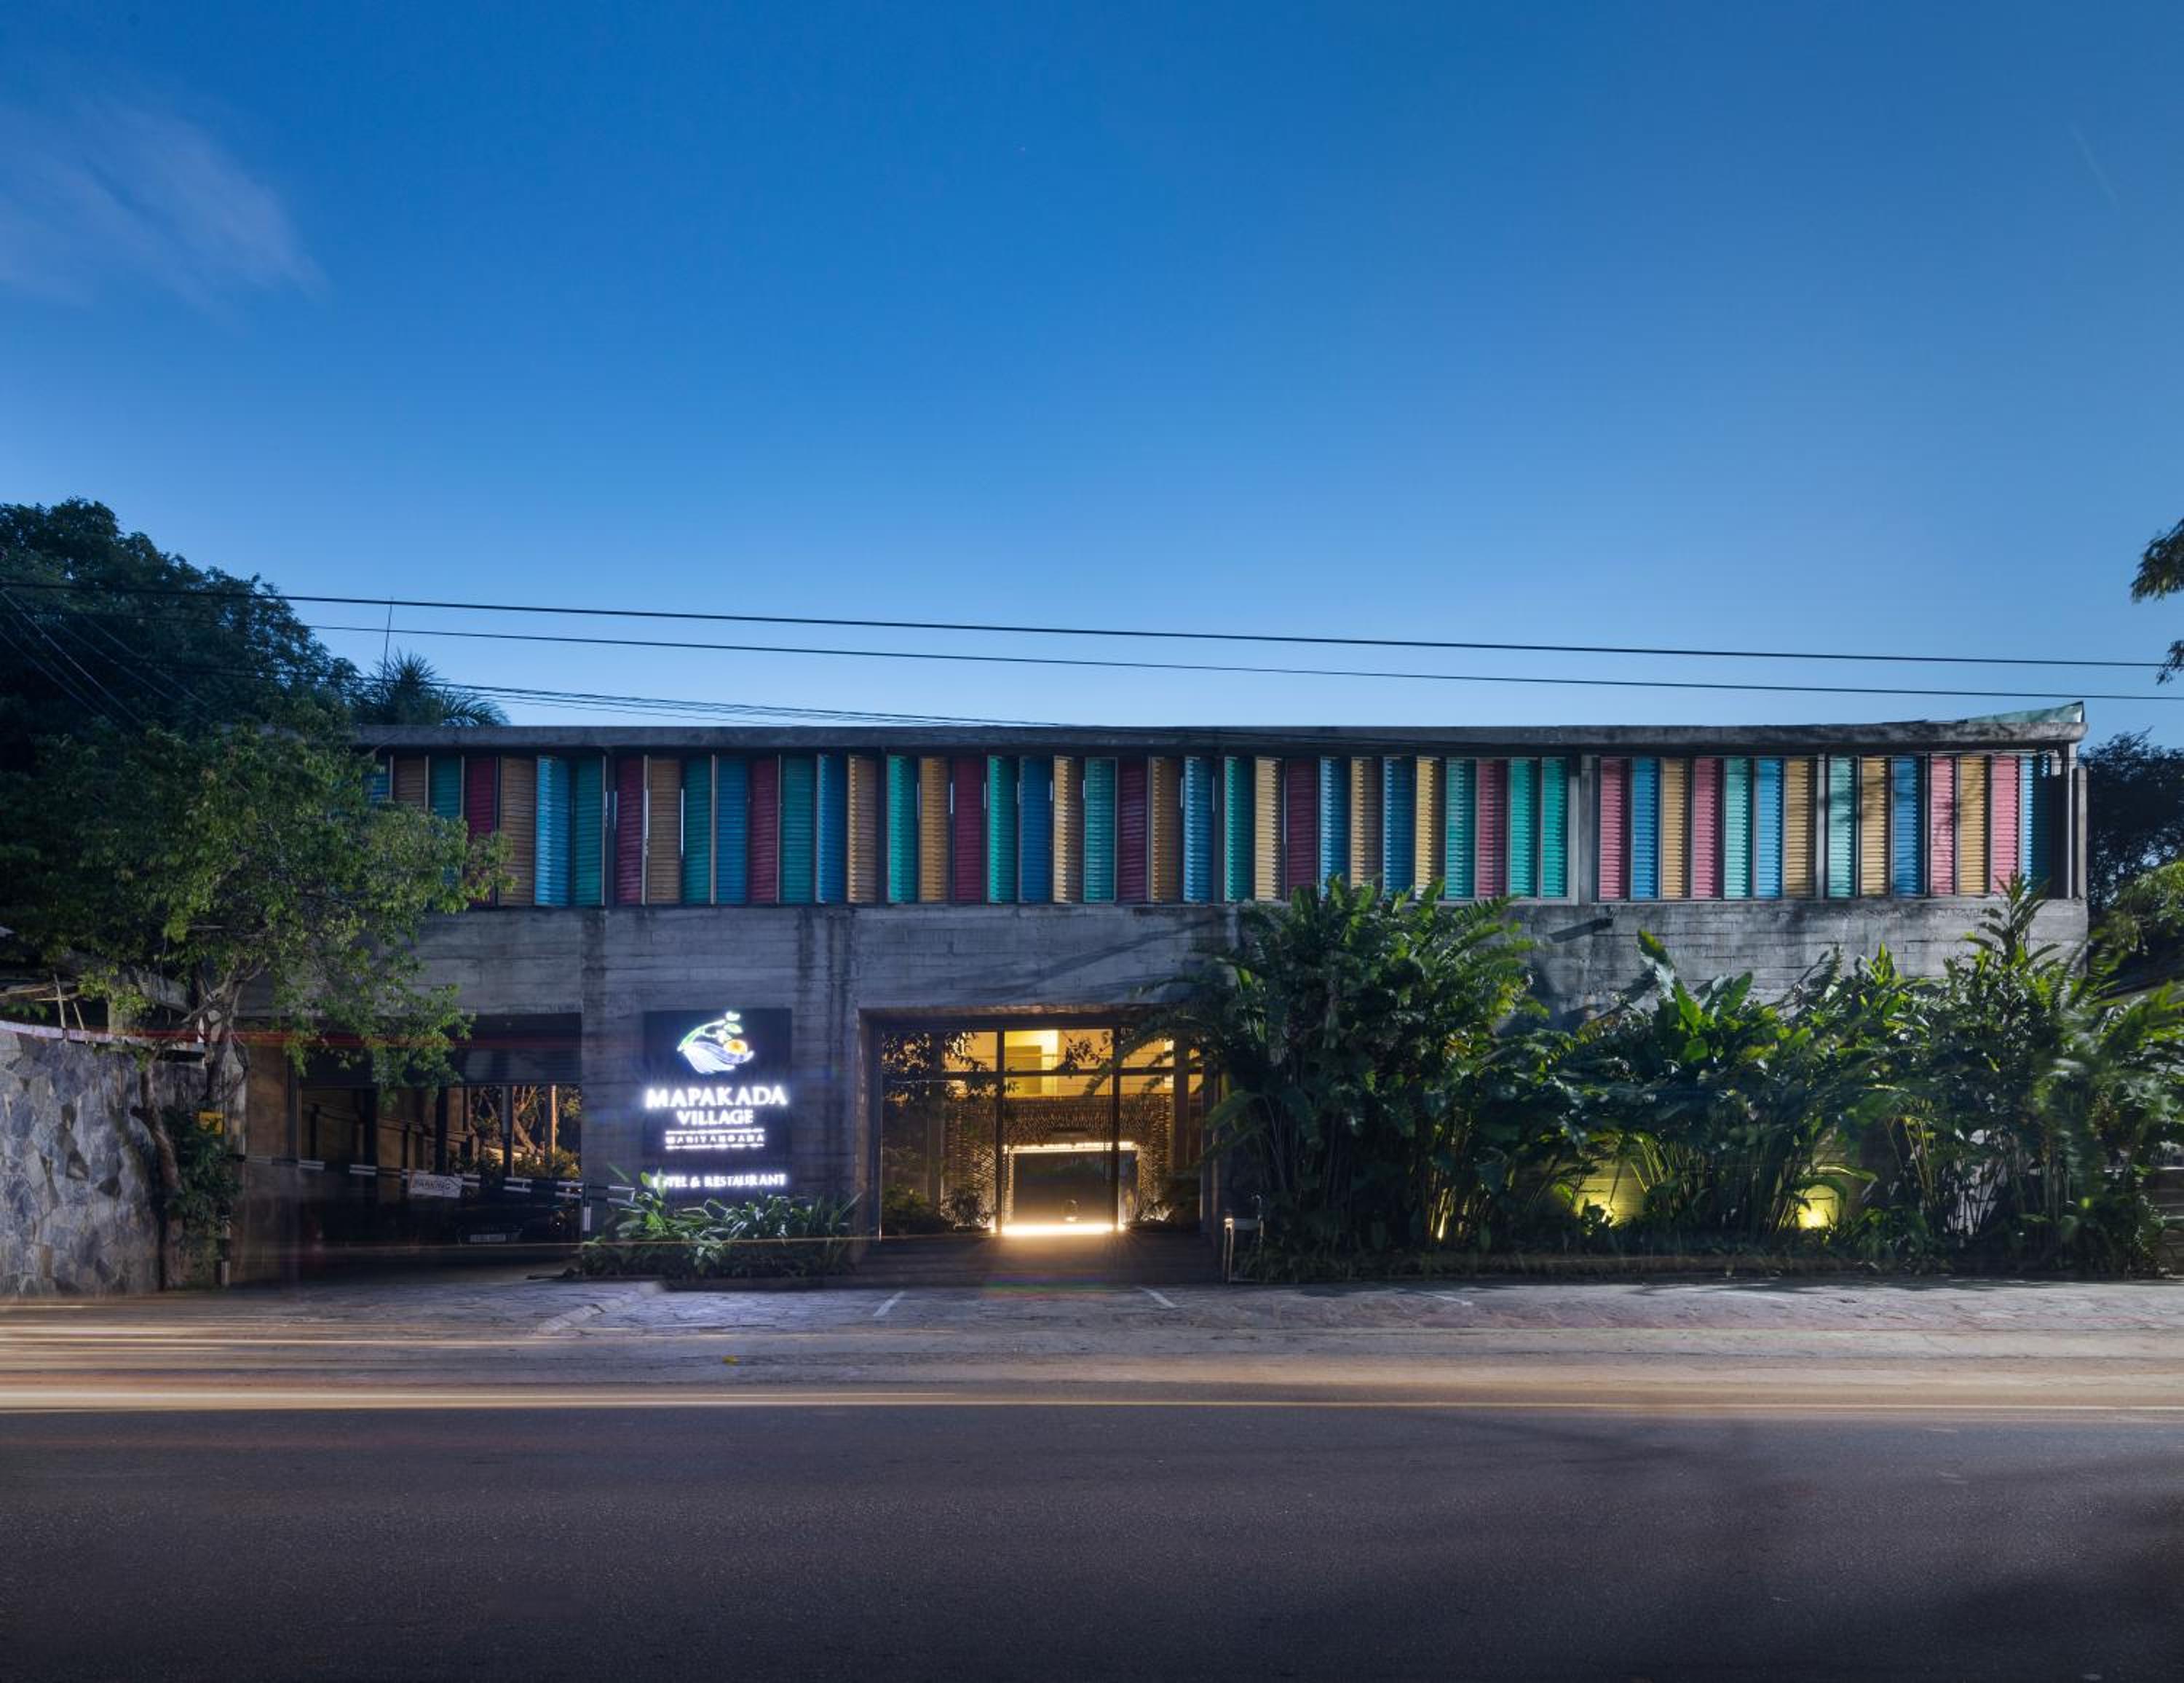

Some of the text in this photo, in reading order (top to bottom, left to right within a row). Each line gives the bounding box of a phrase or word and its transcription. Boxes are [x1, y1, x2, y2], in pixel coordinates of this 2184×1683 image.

[646, 1085, 787, 1108] MAPAKADA
[677, 1109, 753, 1125] VILLAGE
[689, 1176, 700, 1188] &
[704, 1173, 786, 1187] RESTAURANT
